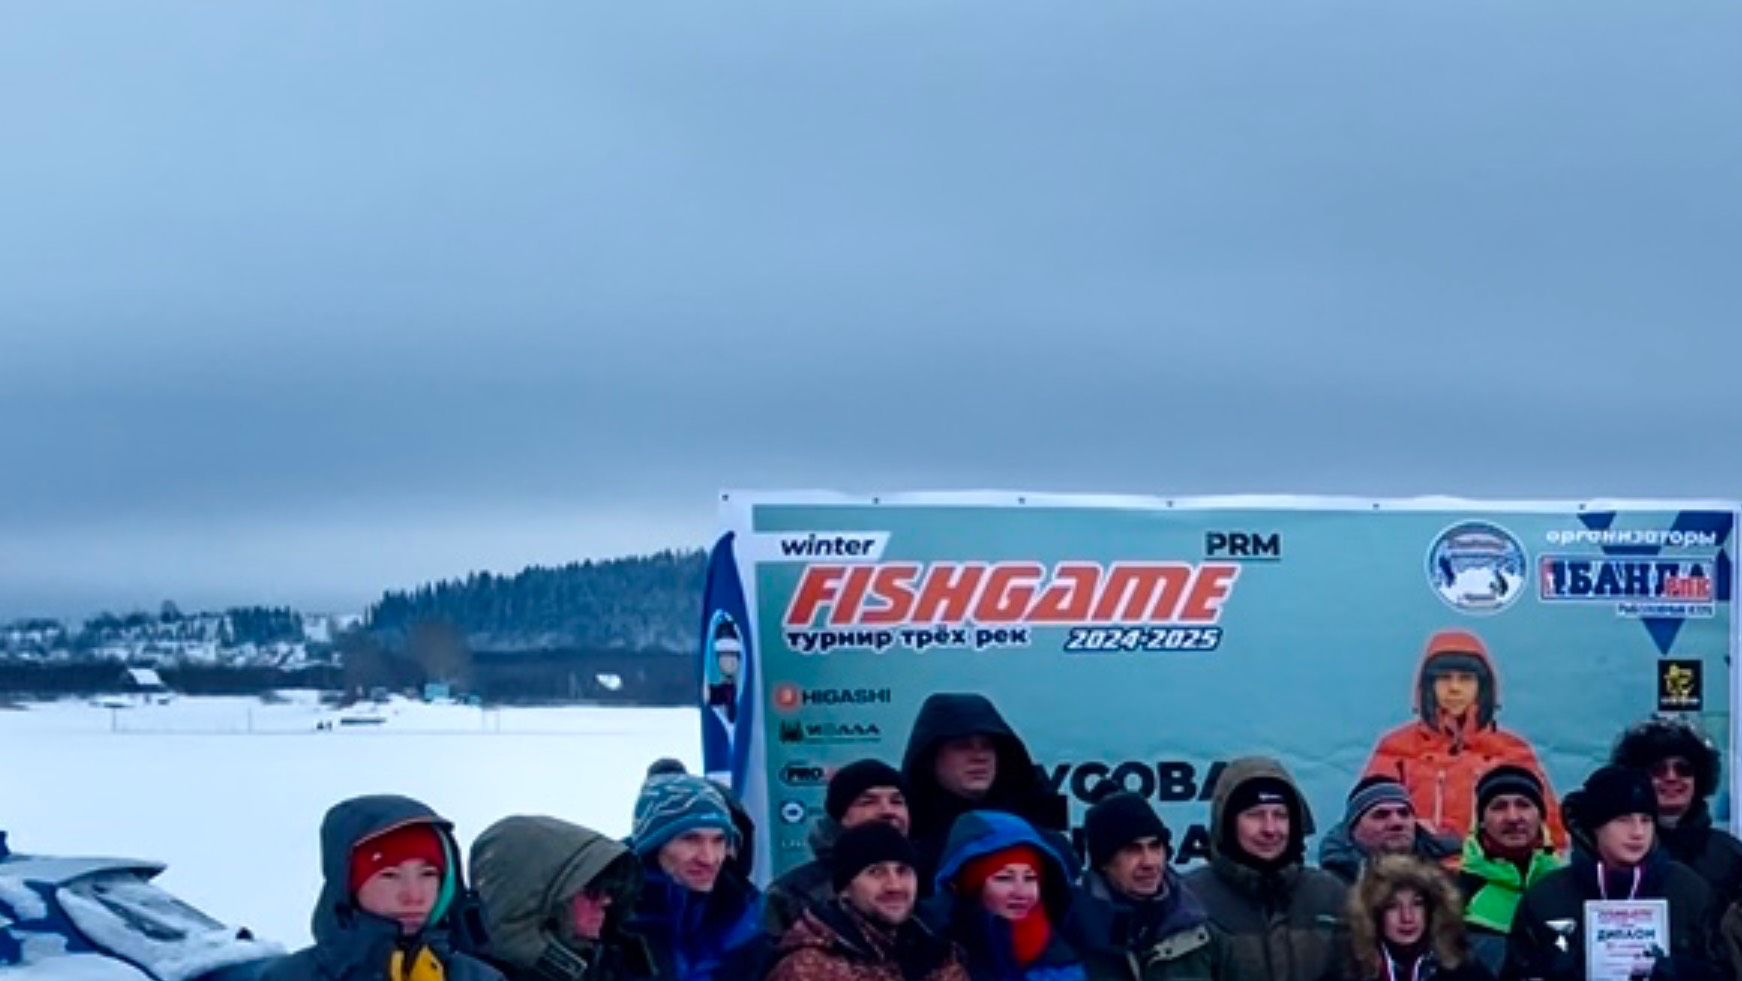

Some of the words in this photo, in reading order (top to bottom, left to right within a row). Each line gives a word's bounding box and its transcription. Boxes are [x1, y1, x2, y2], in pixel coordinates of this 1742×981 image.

[781, 534, 876, 557] winter
[1206, 533, 1281, 557] PRM
[1546, 530, 1717, 546] организаторы
[785, 564, 1240, 627] FISHGAME
[787, 631, 891, 650] турнир
[900, 627, 969, 648] трёх
[976, 630, 1028, 649] рек
[802, 688, 891, 705] HIGASHI
